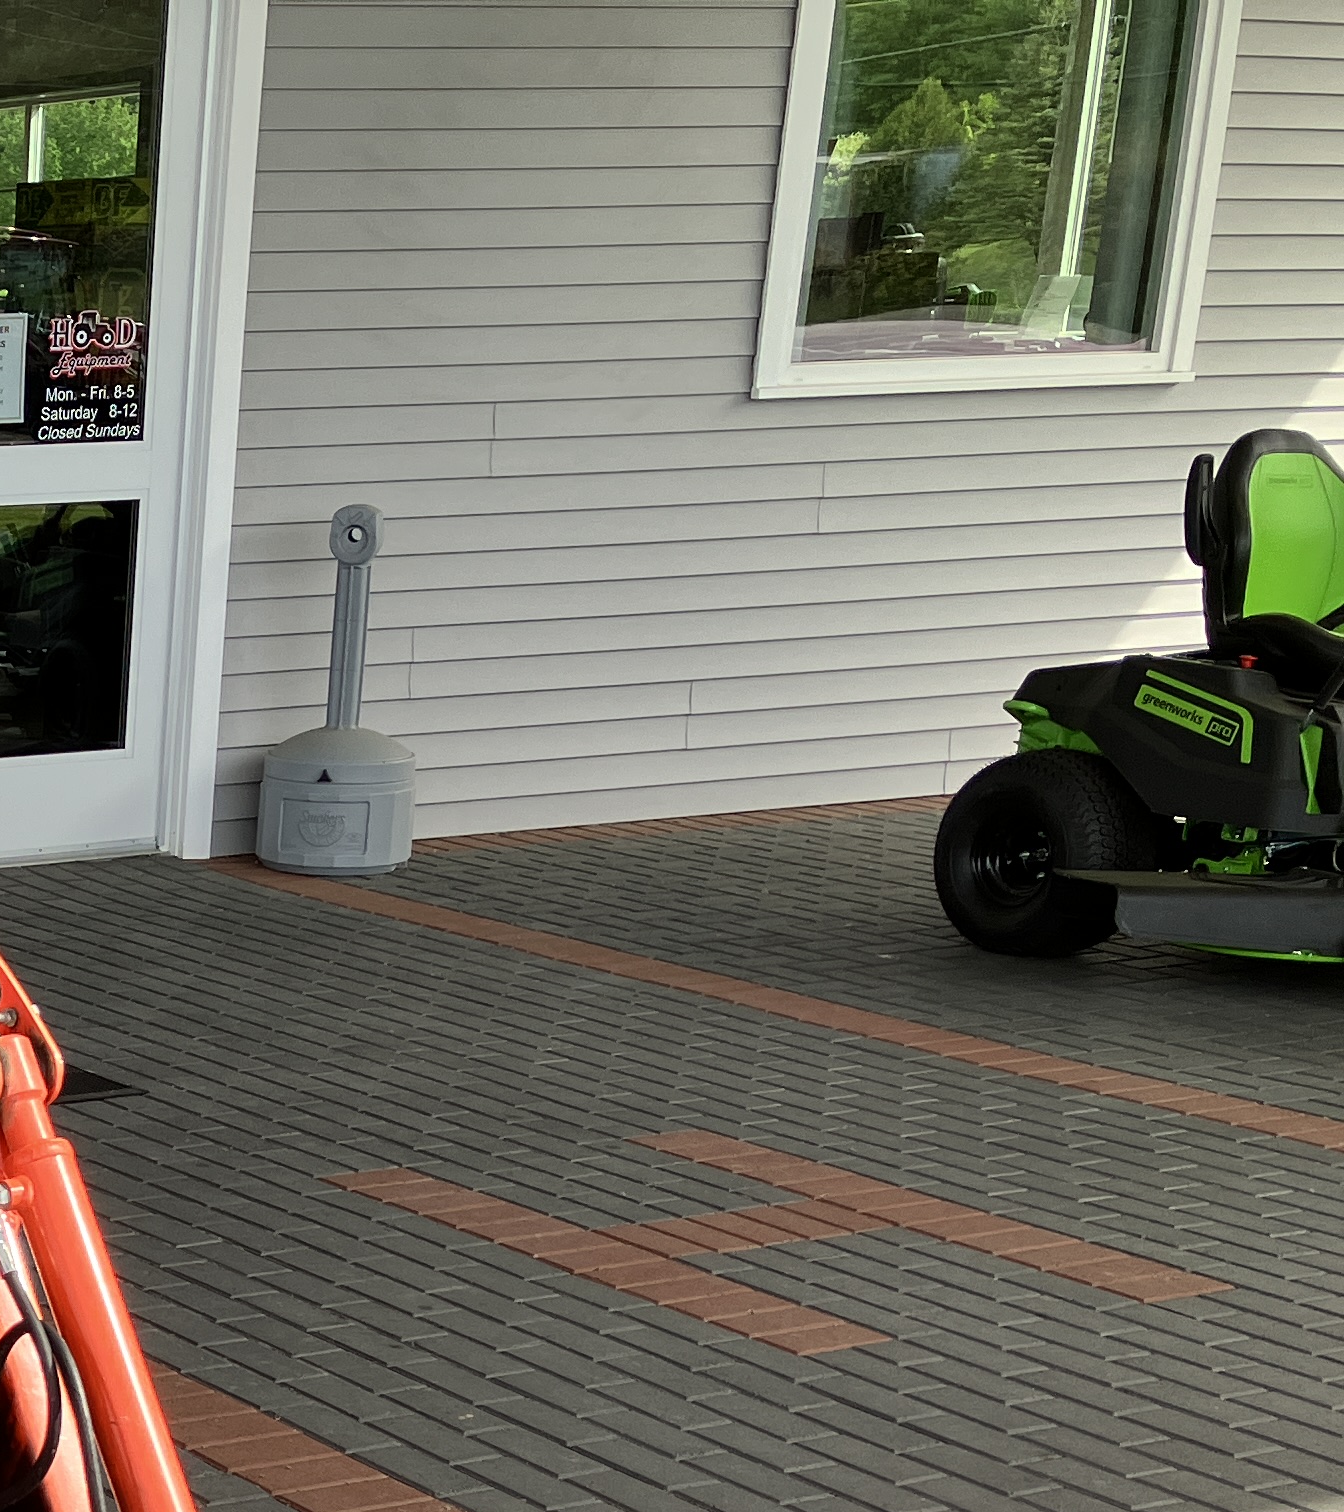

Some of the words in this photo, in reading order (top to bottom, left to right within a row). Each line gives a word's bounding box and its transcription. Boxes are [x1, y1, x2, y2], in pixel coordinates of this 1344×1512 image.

[50, 351, 132, 379] Equipment
[46, 387, 77, 402] Mon.
[90, 385, 110, 400] Fri.
[114, 385, 135, 399] 8-5
[41, 405, 98, 422] Saturday
[109, 403, 137, 418] 8-12
[38, 424, 84, 440] Closed
[86, 423, 141, 439] Sundays
[1141, 693, 1204, 725] greenworks
[1208, 721, 1232, 738] pro
